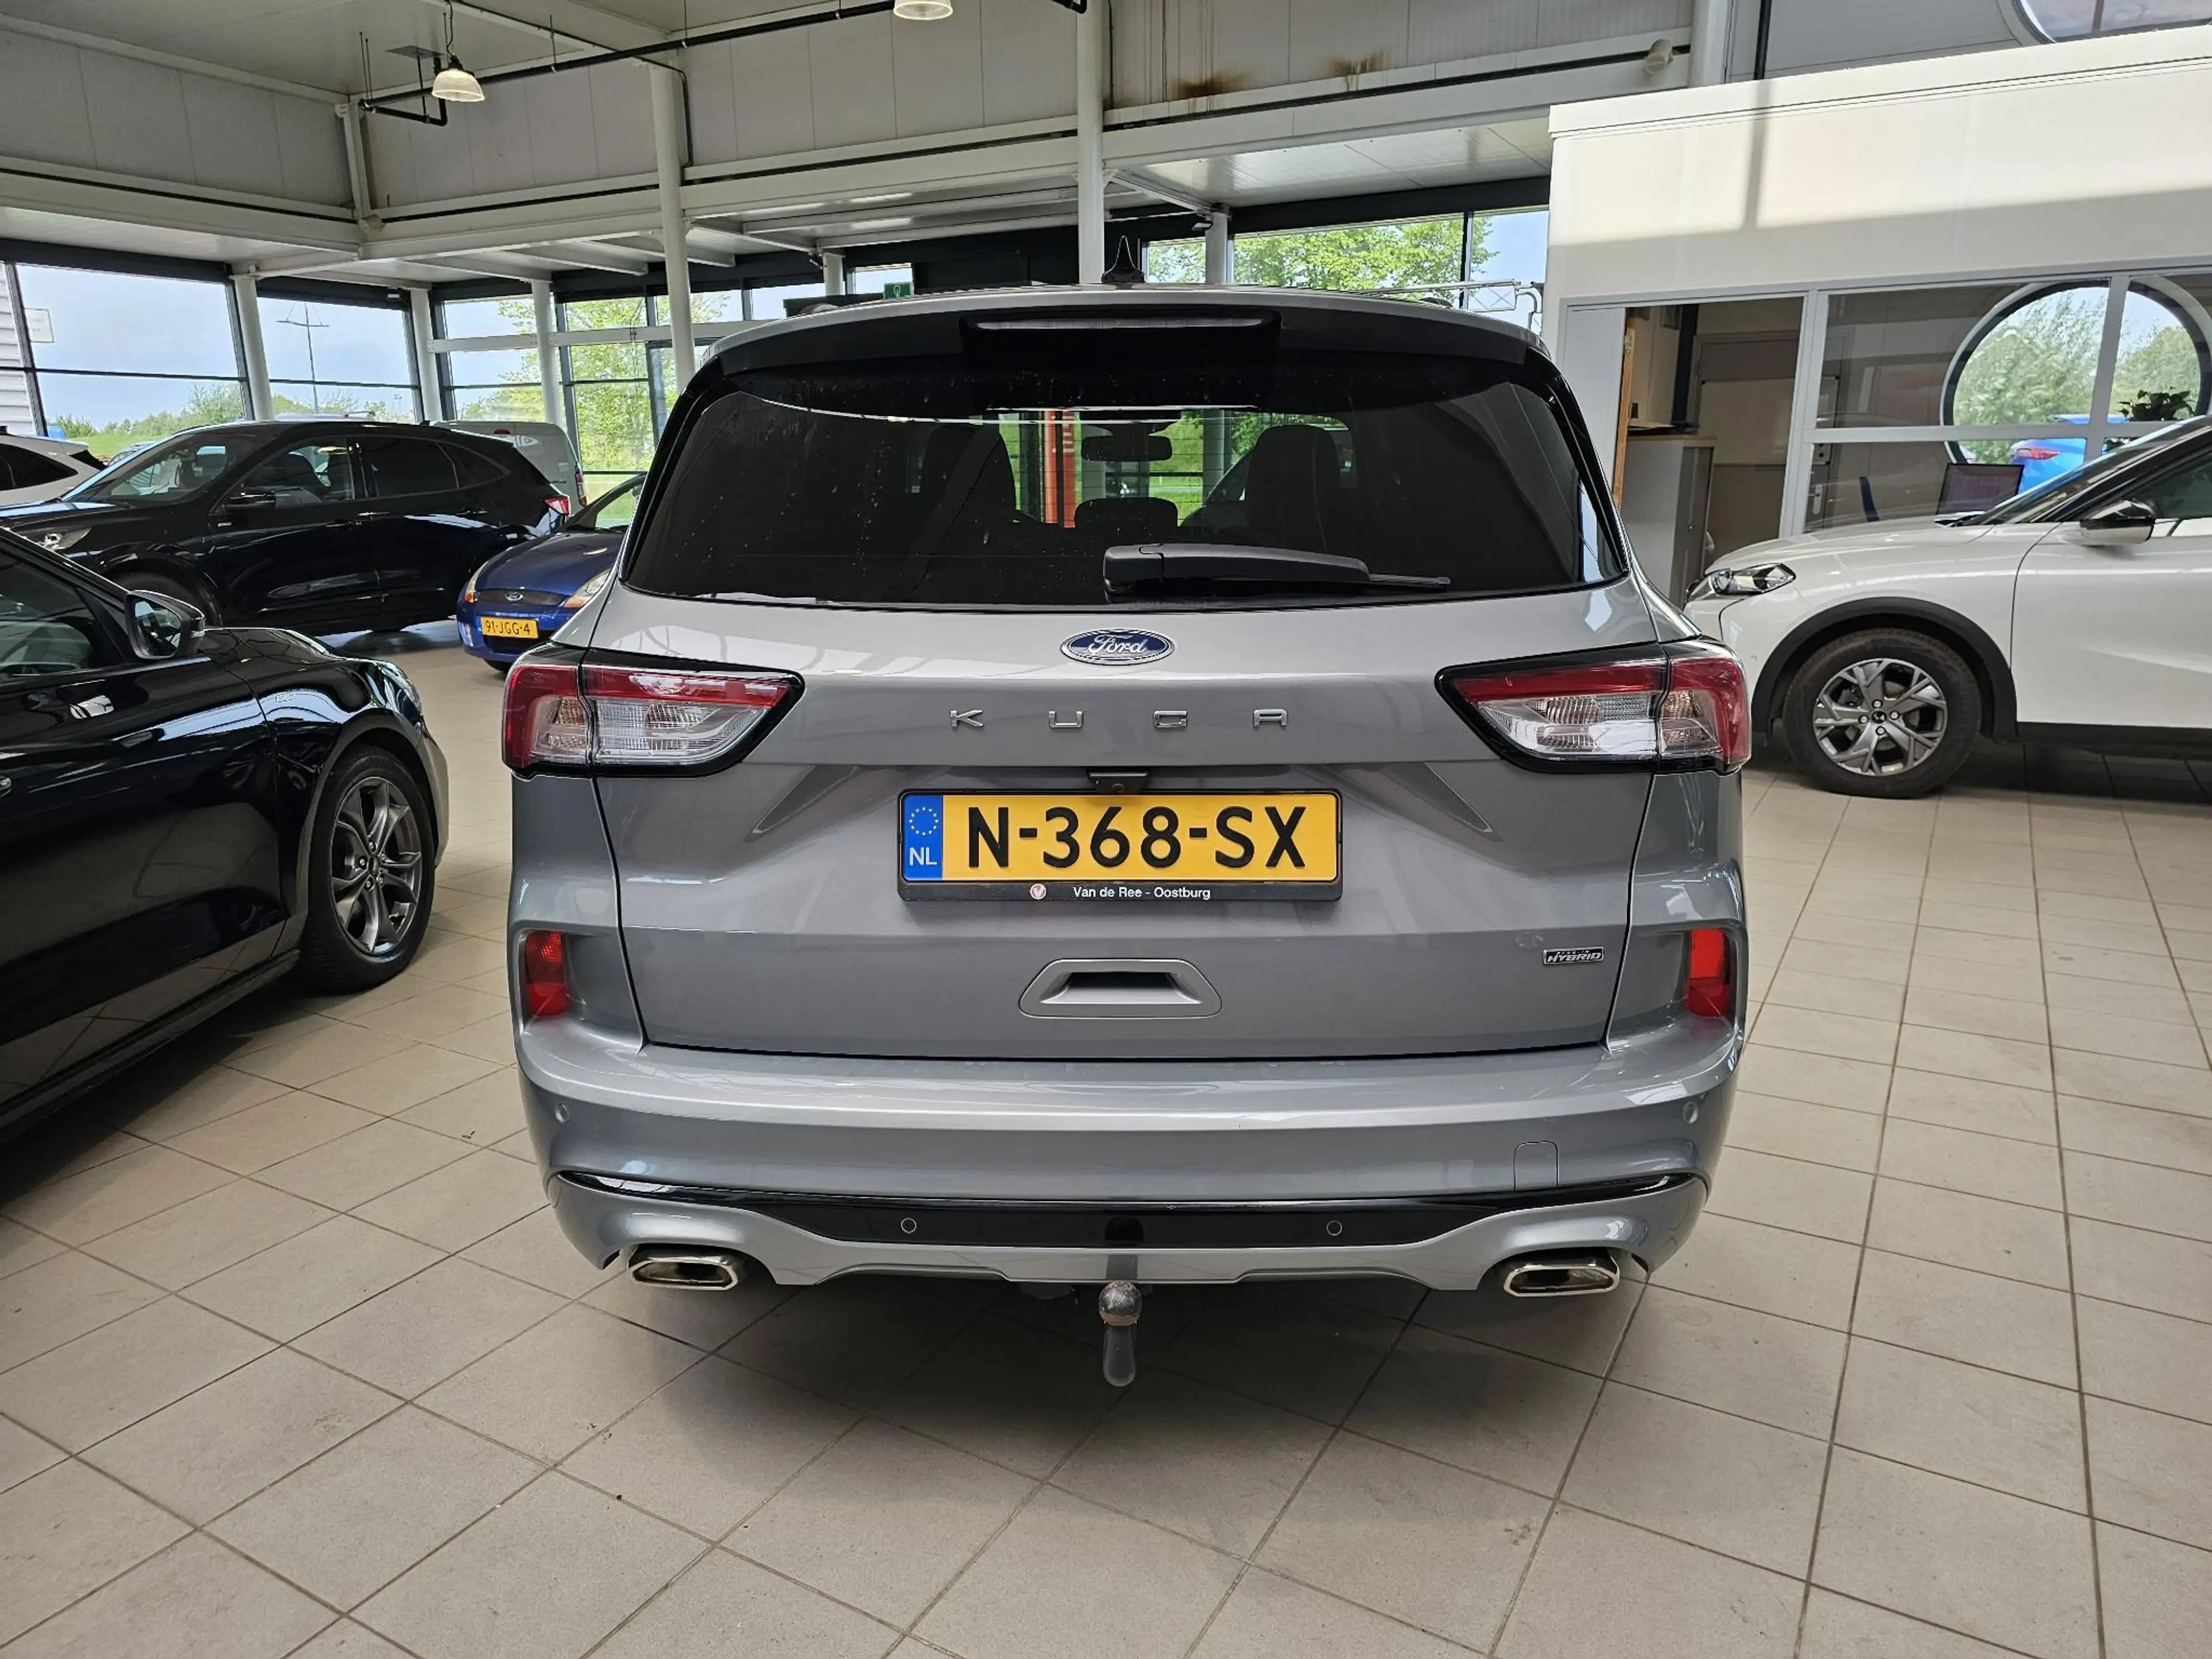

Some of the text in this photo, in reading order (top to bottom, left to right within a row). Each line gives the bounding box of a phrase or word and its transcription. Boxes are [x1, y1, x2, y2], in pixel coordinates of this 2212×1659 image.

[485, 620, 530, 635] 91-JGG-4
[1088, 634, 1149, 654] Ford
[950, 709, 1287, 729] KUGA
[968, 806, 1306, 869] N-368-SX
[908, 846, 937, 866] NL
[1073, 886, 1096, 898] Van
[1099, 886, 1115, 898] de
[1118, 887, 1143, 898] Ree
[1154, 886, 1211, 900] Oostburg
[1546, 952, 1601, 963] HYBRID
